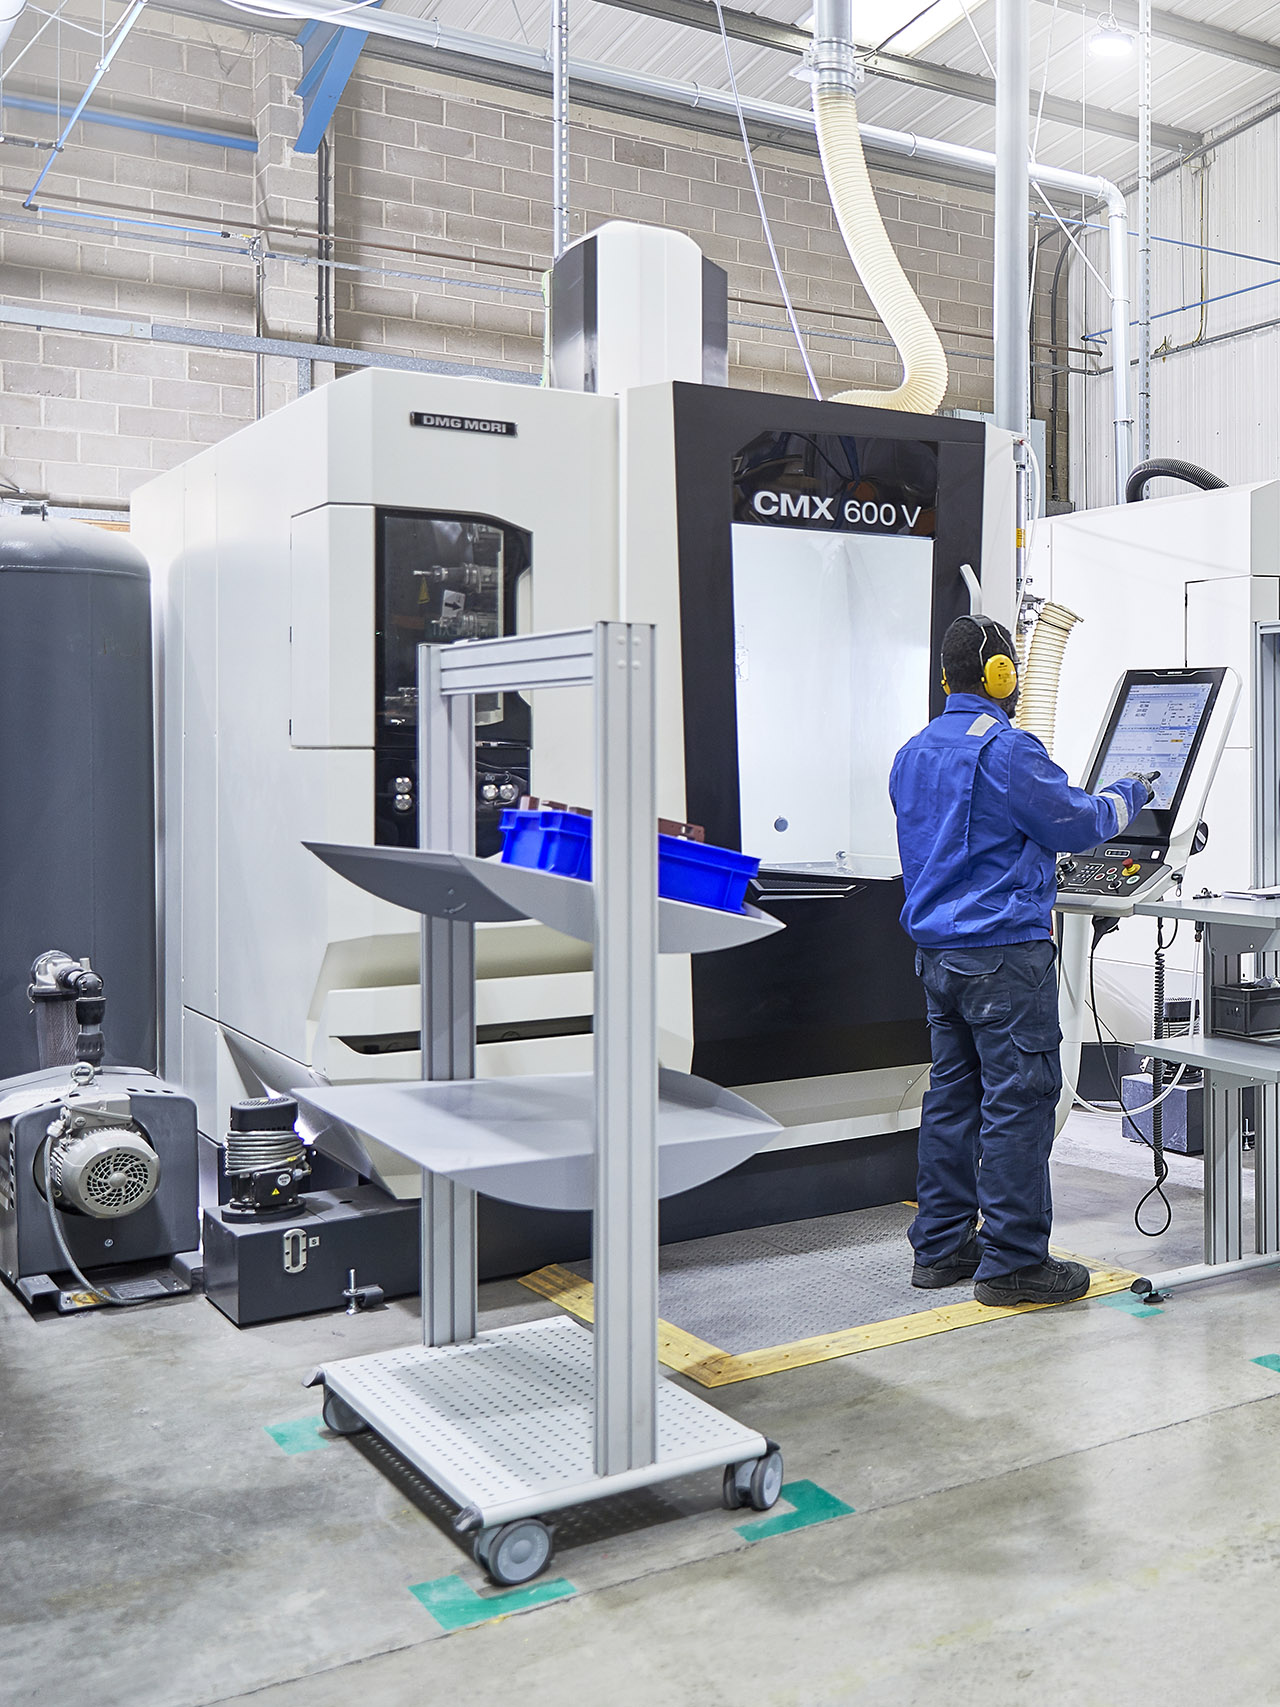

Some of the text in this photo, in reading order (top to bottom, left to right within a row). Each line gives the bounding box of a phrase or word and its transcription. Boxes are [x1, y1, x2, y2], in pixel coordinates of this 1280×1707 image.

[423, 415, 507, 433] DMG MORI
[753, 491, 922, 528] CMX 600 V
